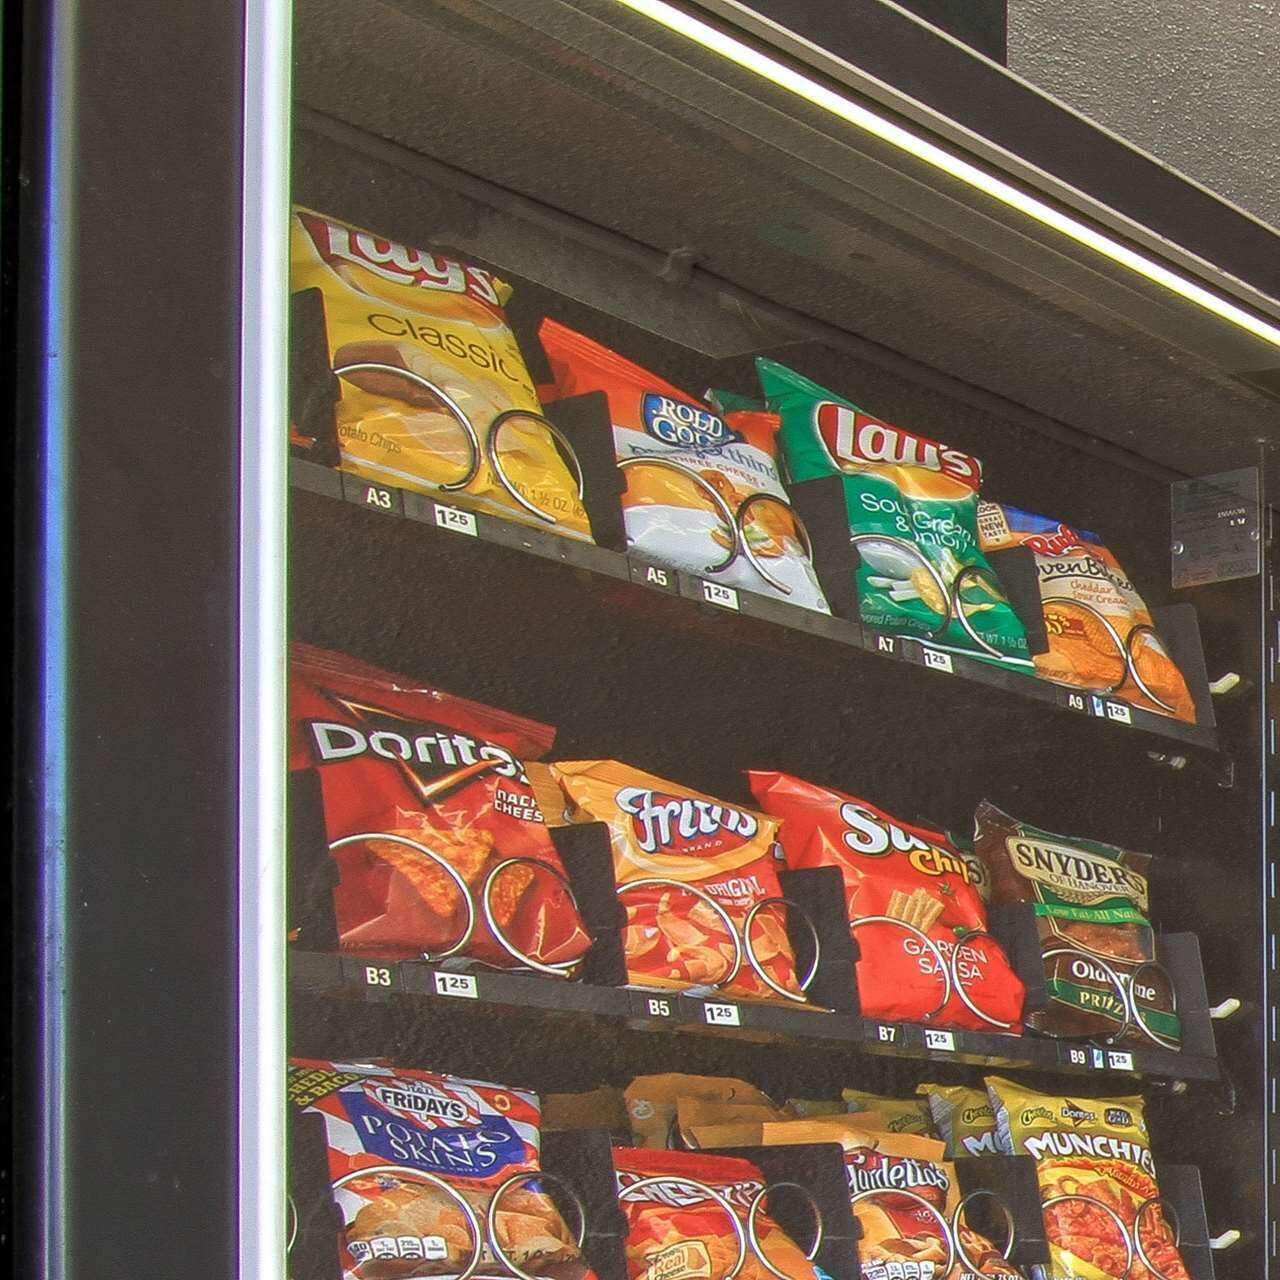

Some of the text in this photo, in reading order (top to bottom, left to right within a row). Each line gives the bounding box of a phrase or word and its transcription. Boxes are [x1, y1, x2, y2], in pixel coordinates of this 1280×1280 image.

[366, 487, 392, 508] A3
[980, 521, 1005, 533] NEW
[647, 567, 668, 586] A5
[878, 636, 894, 652] A7
[1068, 694, 1084, 710] A9
[365, 967, 392, 986] B3
[918, 957, 985, 980] SASA
[649, 999, 670, 1016] B5
[878, 1026, 897, 1042] B7
[1069, 1049, 1086, 1065] B9
[390, 1138, 498, 1168] SKINS
